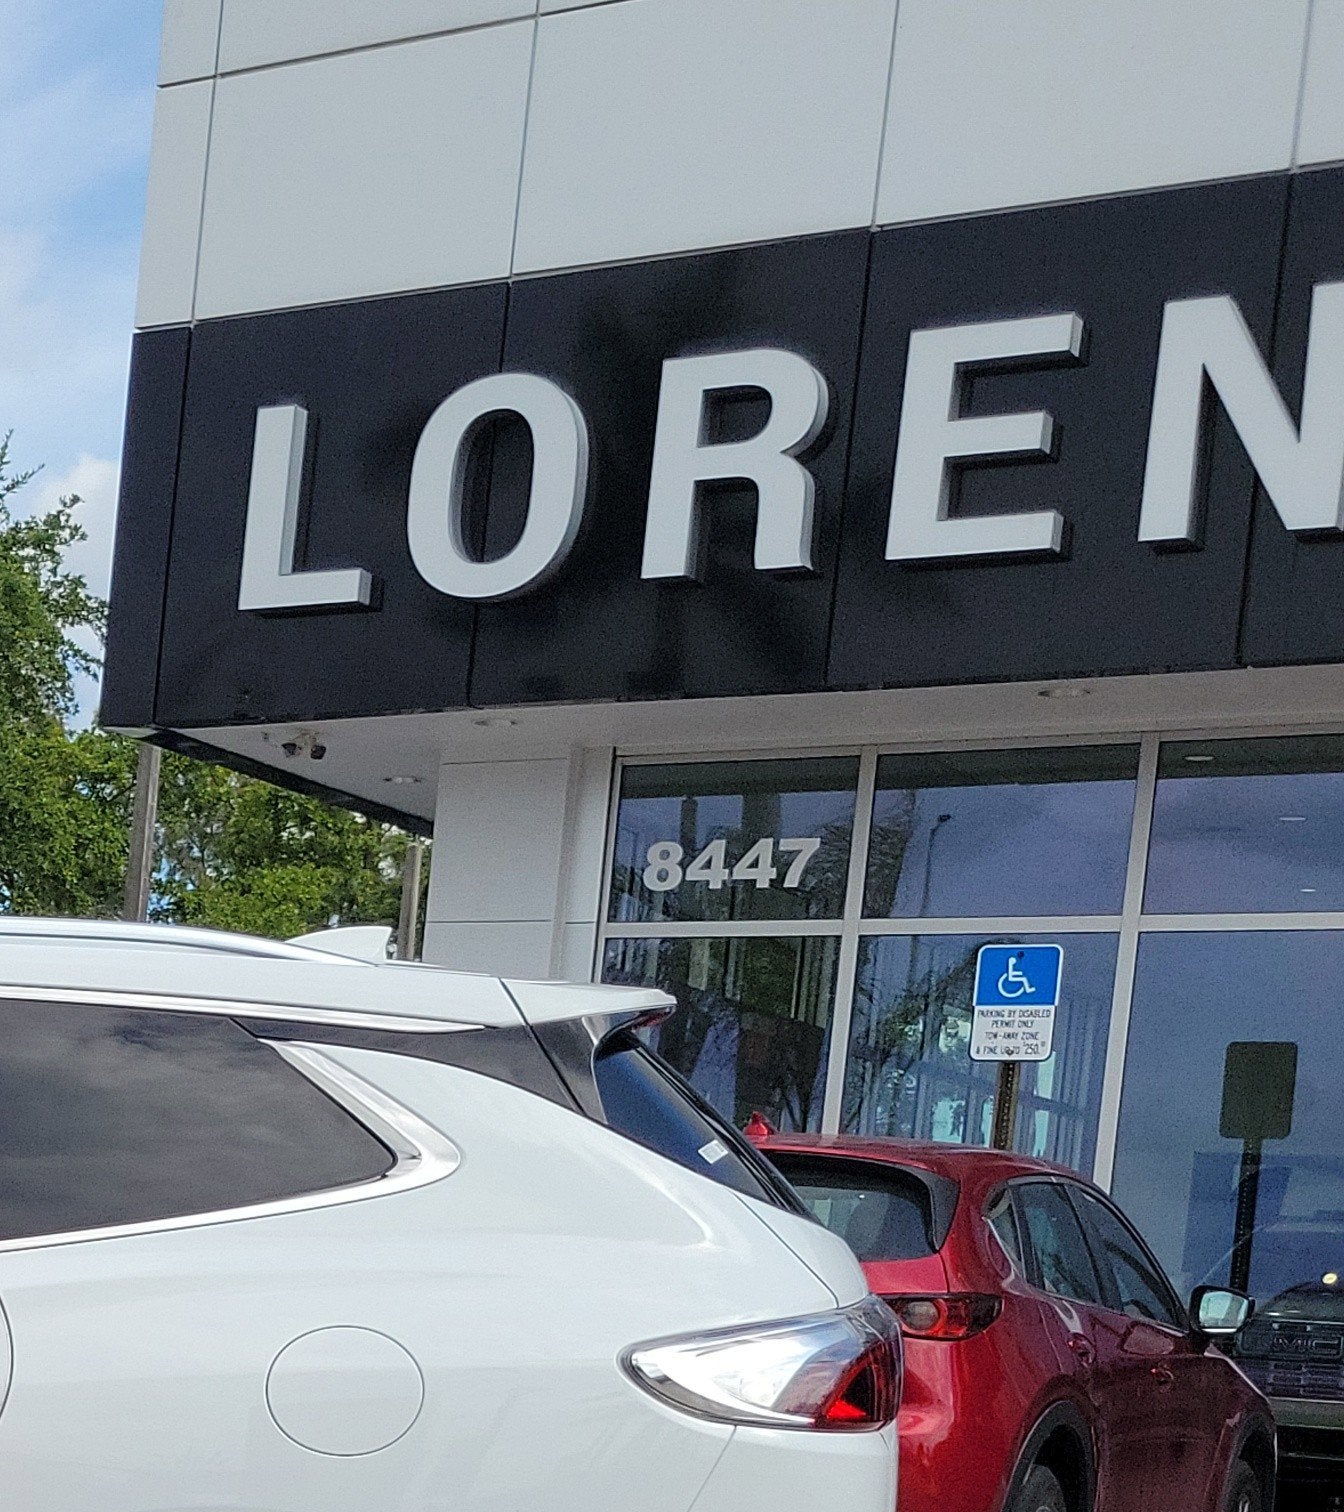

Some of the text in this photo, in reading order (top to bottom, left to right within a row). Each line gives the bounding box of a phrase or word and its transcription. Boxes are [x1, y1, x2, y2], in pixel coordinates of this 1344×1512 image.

[238, 280, 1344, 610] LOREN
[643, 837, 821, 891] 8447
[977, 1009, 1051, 1019] PARKING BY DISABLED
[991, 1020, 1034, 1028] PERMIT ONLY
[985, 1031, 1040, 1040] TOW-AWAY ZONE
[983, 1046, 998, 1055] FINE
